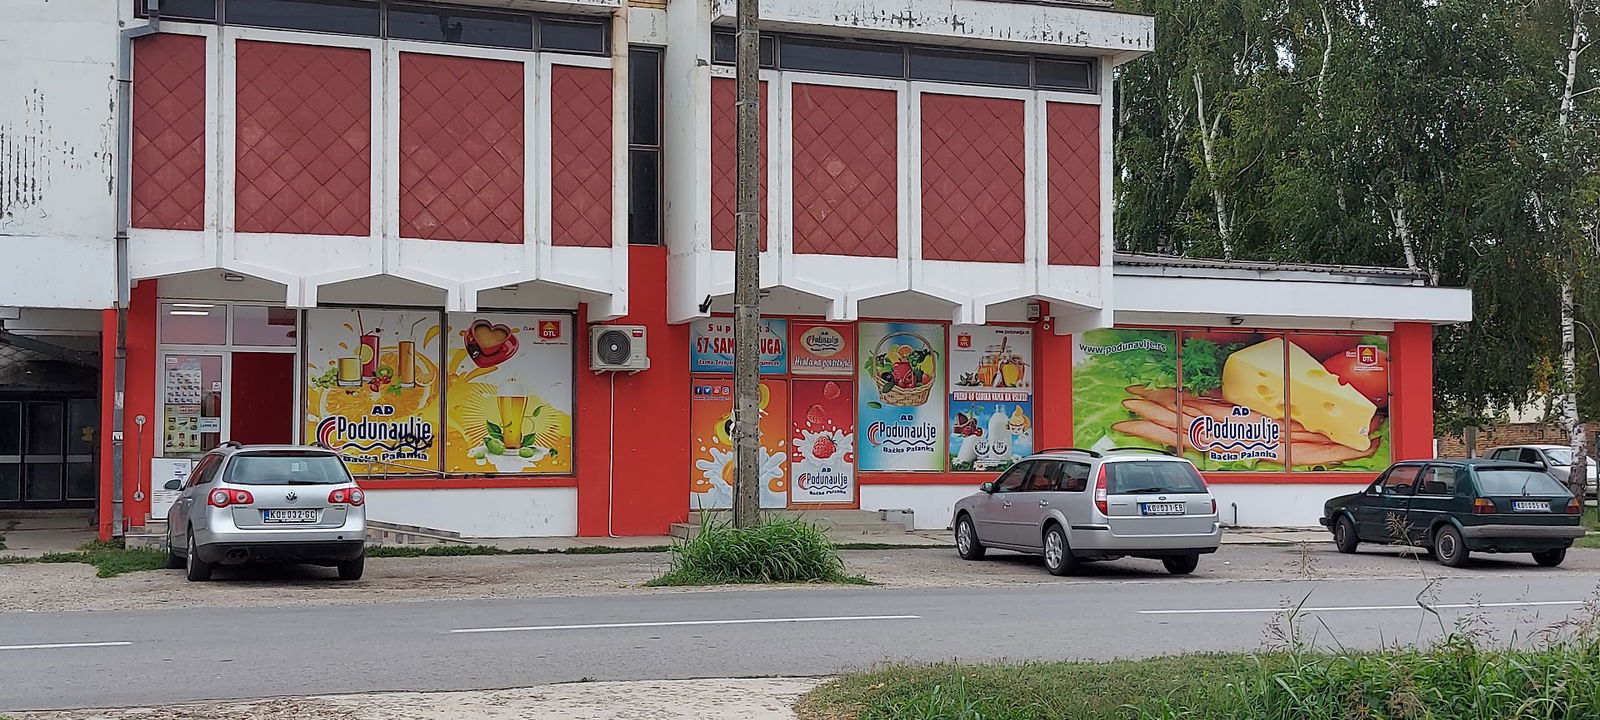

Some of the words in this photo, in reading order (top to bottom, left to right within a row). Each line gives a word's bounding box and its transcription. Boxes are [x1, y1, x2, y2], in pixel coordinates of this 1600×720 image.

[697, 337, 709, 353] 57
[713, 337, 781, 354] SAMUGA
[1079, 339, 1167, 356] www.podunavlje.rs
[371, 405, 394, 415] AD
[1232, 407, 1250, 416] AD
[337, 416, 431, 446] Podunavlje
[879, 421, 937, 442] Podunavlje
[1205, 416, 1279, 444] Podunavlje
[906, 445, 935, 453] Palanka
[1241, 450, 1277, 459] Palanka
[806, 472, 848, 487] Podunavlje
